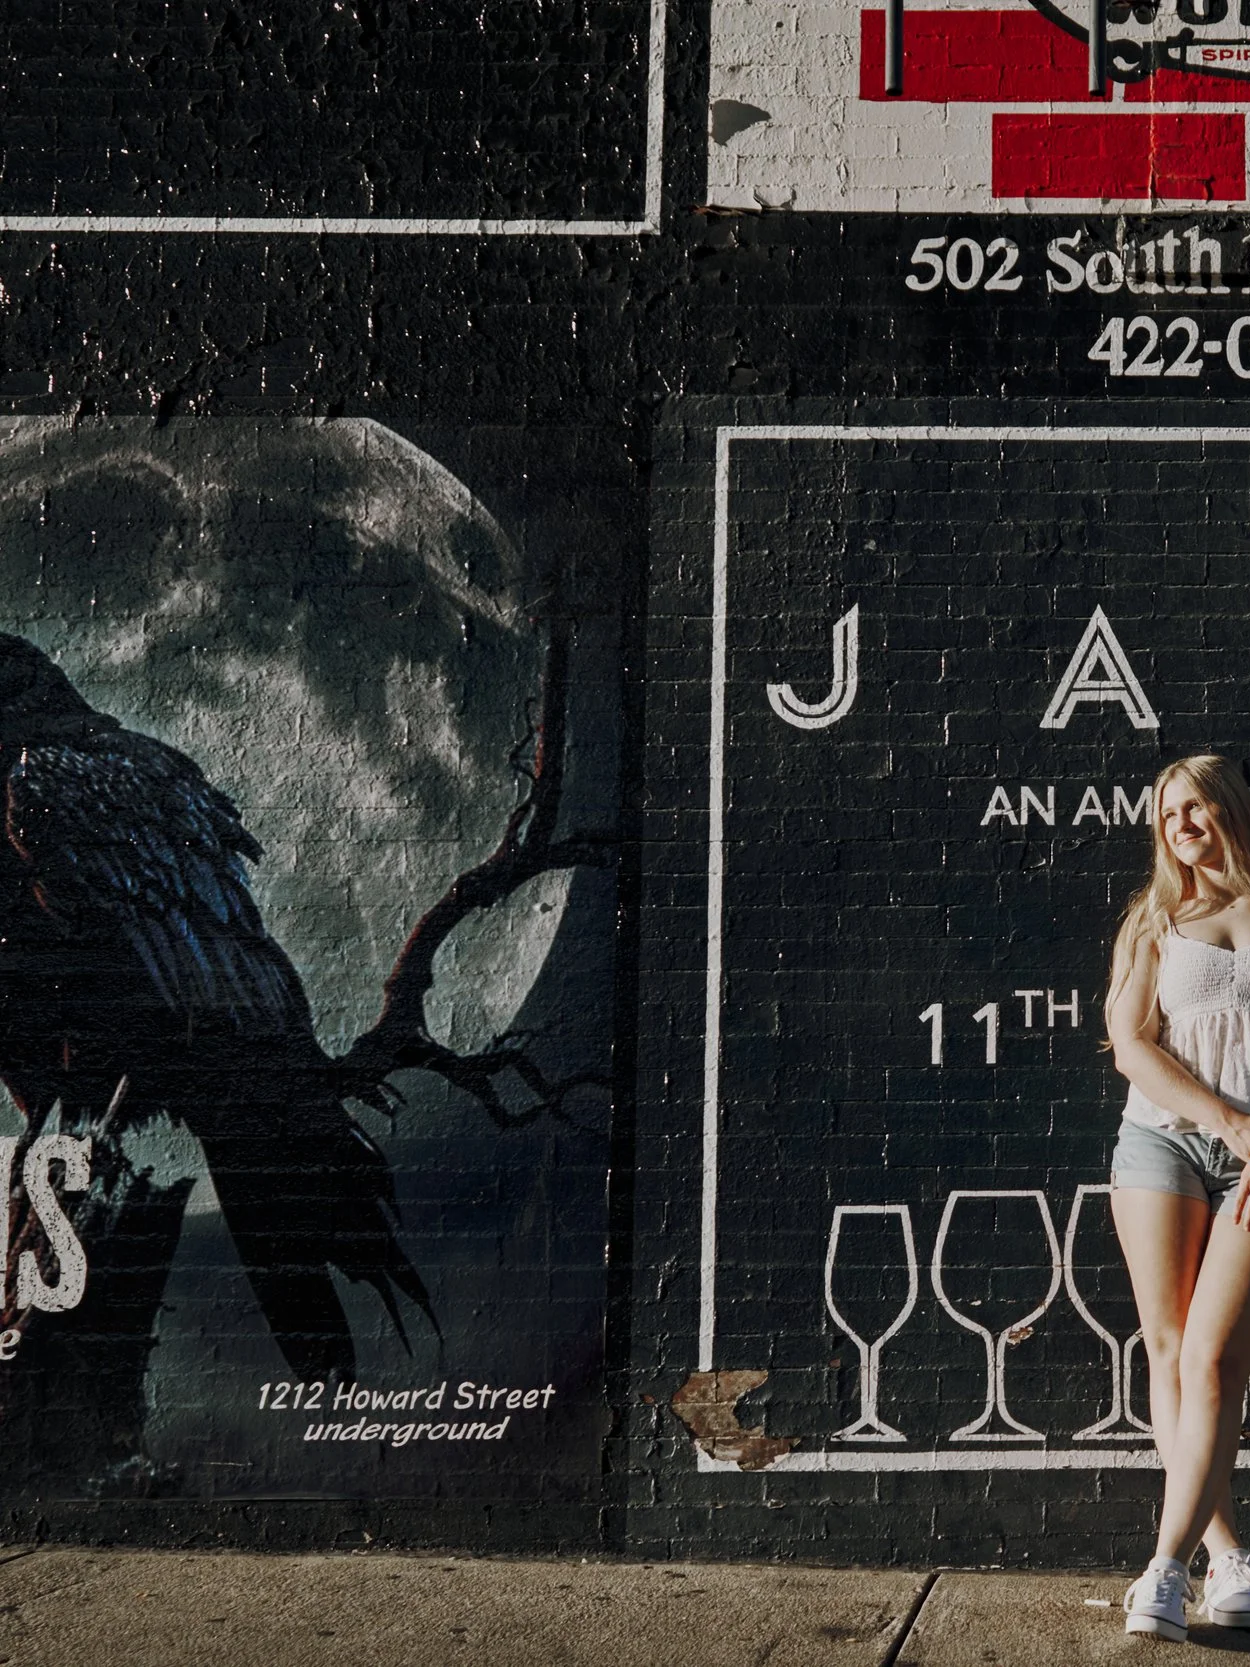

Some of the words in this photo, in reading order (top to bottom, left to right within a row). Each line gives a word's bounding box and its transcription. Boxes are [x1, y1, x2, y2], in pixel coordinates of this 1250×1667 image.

[905, 236, 1023, 292] 502
[1046, 224, 1231, 294] South
[980, 785, 1056, 826] AN
[918, 988, 1079, 1064] 11TH
[258, 1382, 326, 1411] 1212
[333, 1381, 447, 1411] Howard
[454, 1381, 556, 1410] Street
[303, 1416, 511, 1448] underground
